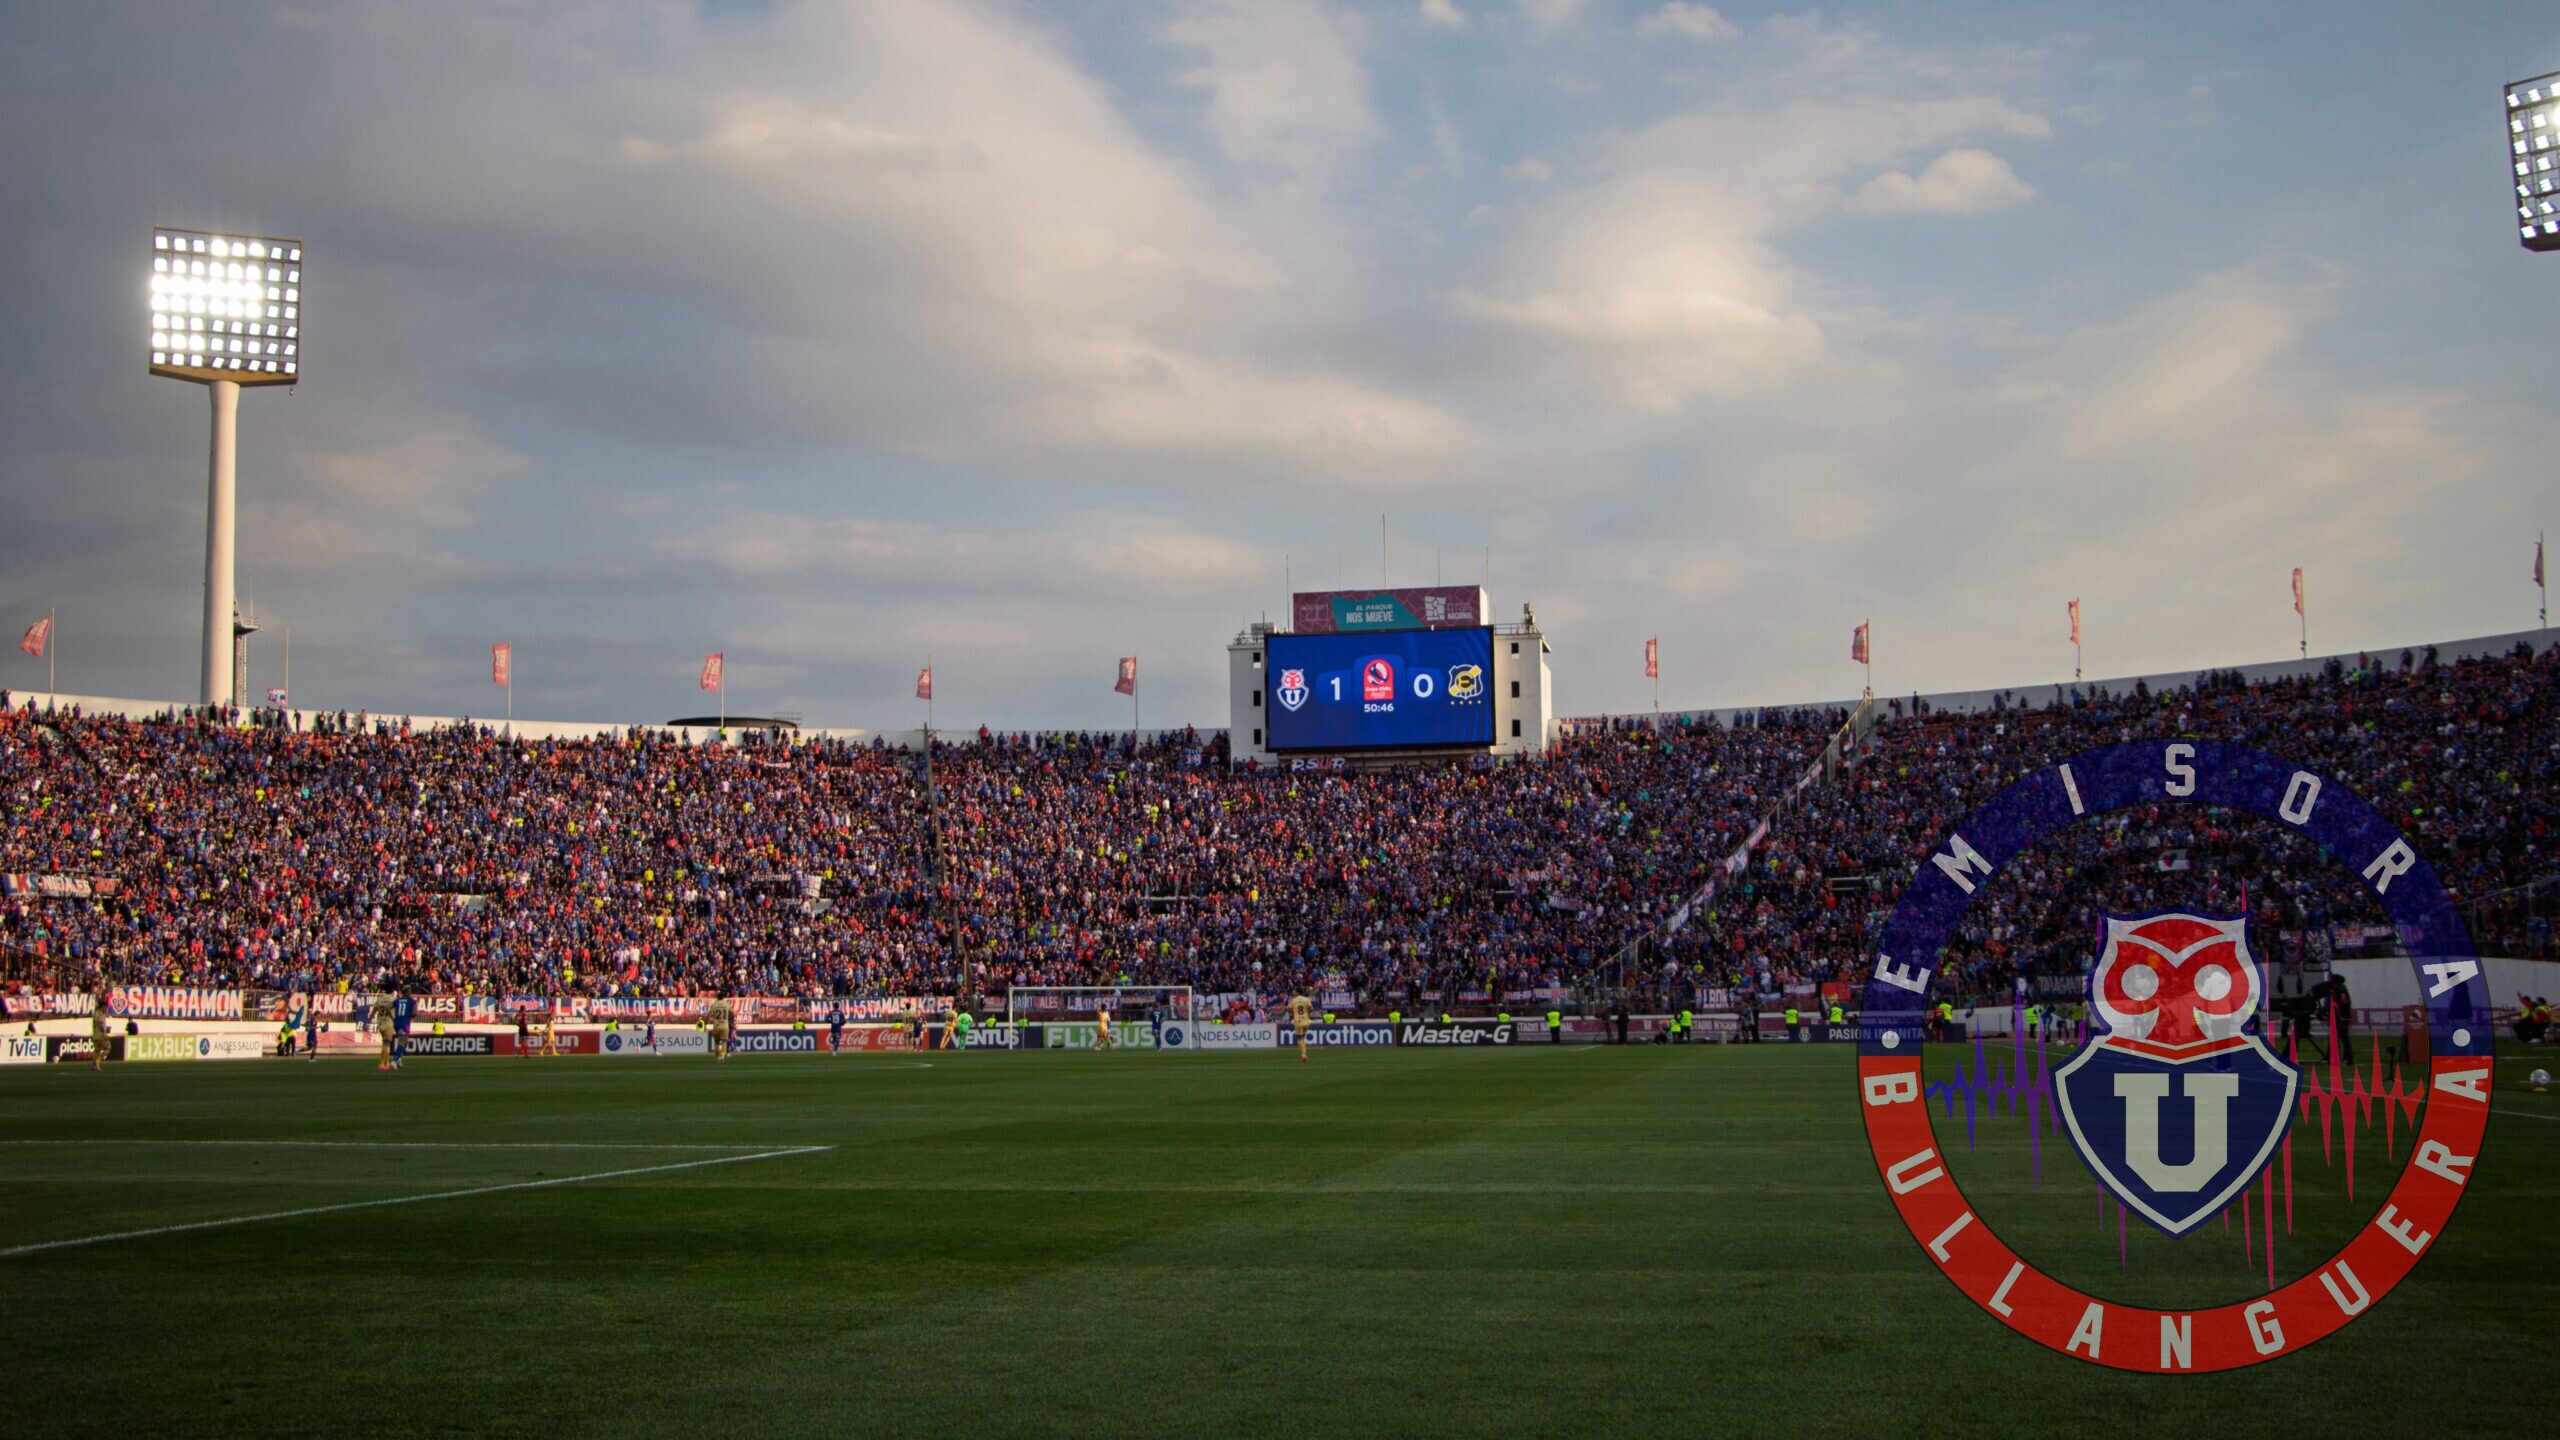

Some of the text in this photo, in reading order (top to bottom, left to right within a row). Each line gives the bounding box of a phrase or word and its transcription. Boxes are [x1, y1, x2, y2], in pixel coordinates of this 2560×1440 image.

[1346, 611, 1393, 623] NOS MUEVE
[1447, 611, 1474, 620] NACIONAL
[1330, 677, 1341, 700] 1
[1413, 674, 1434, 698] 0
[1364, 703, 1395, 713] 50:46
[399, 1003, 406, 1016] 11
[716, 1009, 727, 1020] 21
[1297, 1005, 1304, 1015] 8
[1192, 1030, 1271, 1042] ANDES SALUD
[1280, 1025, 1392, 1045] marathon
[1402, 1025, 1512, 1043] Master-G
[9, 1038, 42, 1057] TvTel
[214, 1040, 260, 1051] ANDES SALUD
[628, 1036, 703, 1048] ANES SALUD
